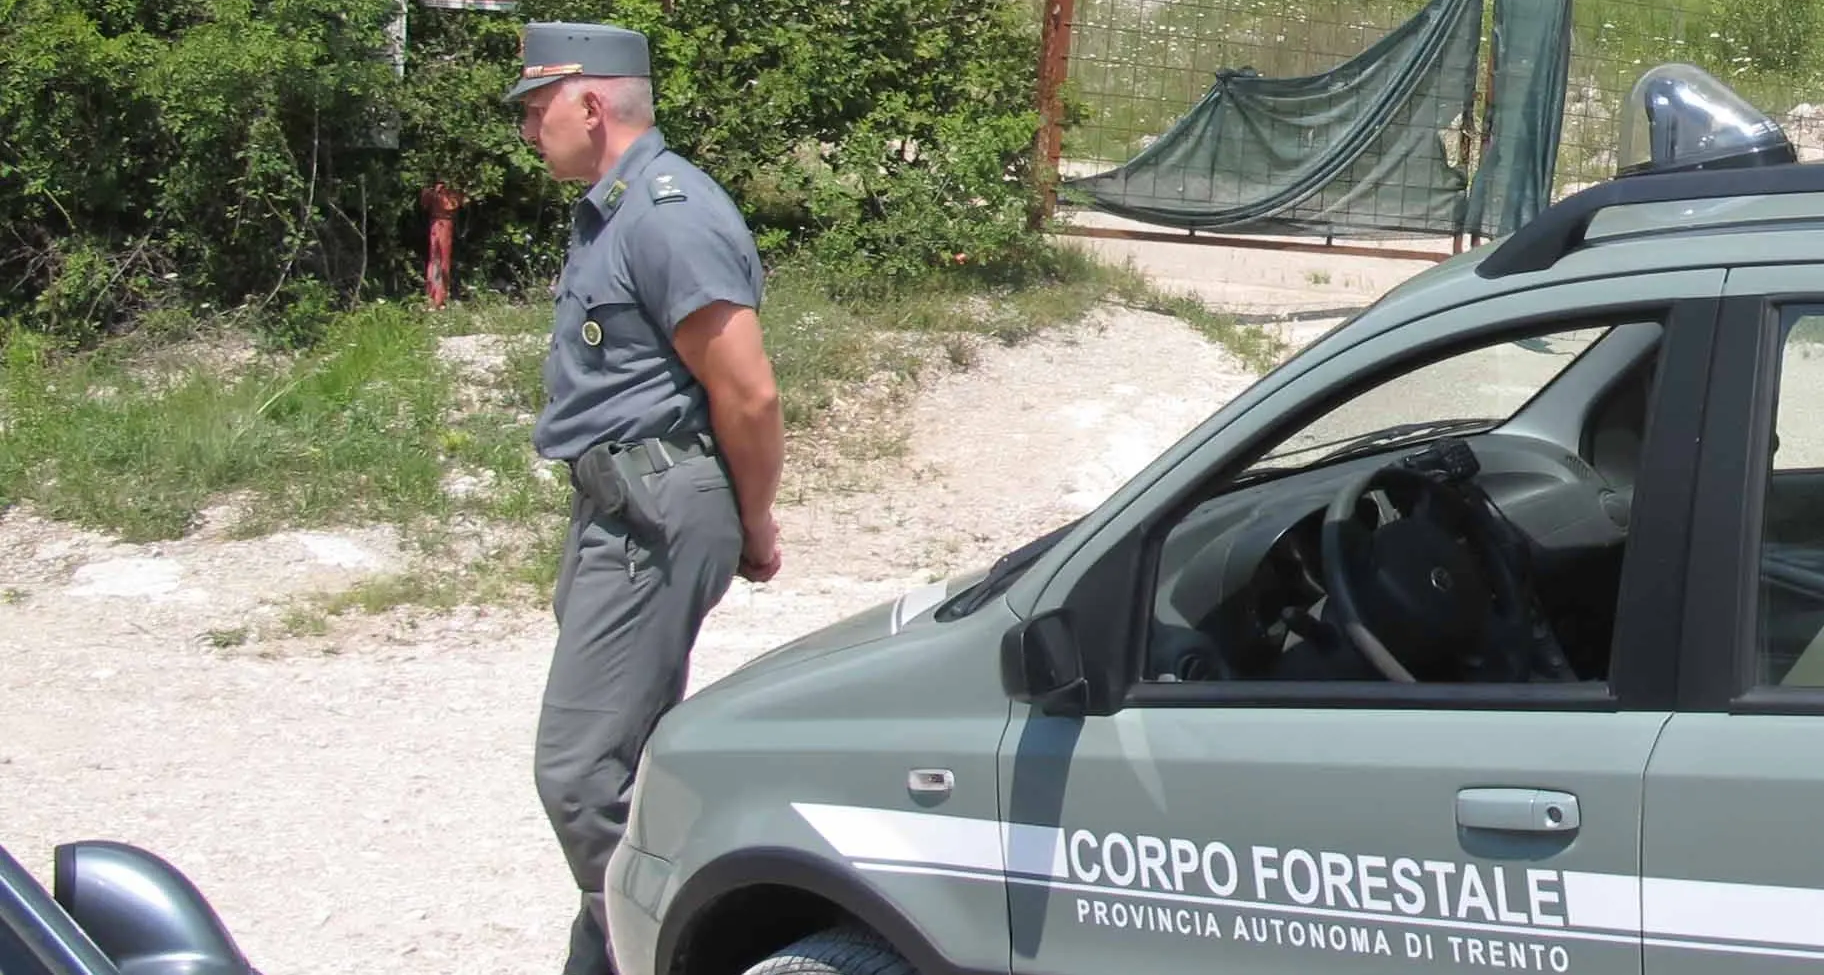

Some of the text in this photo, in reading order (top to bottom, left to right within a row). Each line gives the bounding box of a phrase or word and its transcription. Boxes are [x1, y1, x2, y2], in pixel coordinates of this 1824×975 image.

[1070, 829, 1565, 926] CORPO FORESTALE
[1076, 898, 1569, 973] PROVINCIA AUTONOMA DI TRENTO
